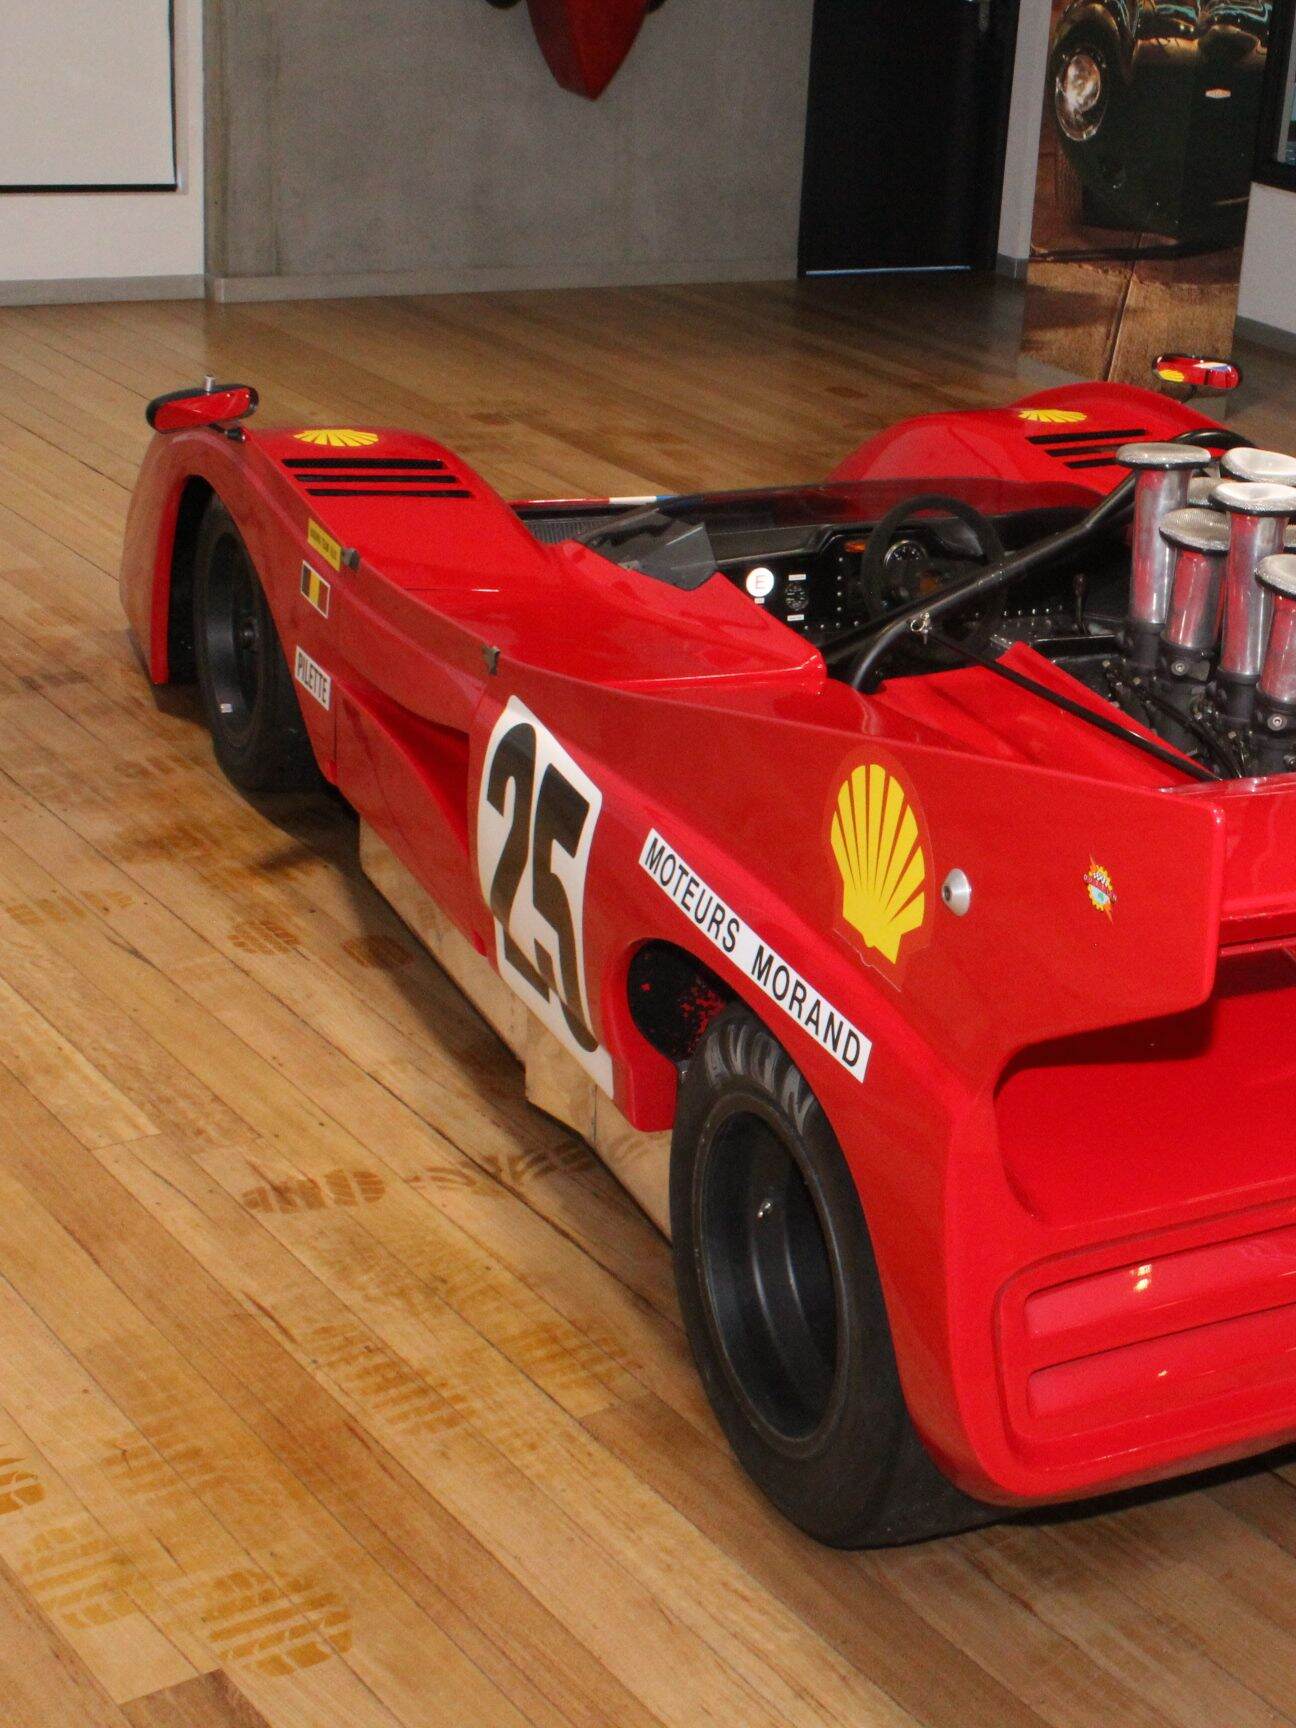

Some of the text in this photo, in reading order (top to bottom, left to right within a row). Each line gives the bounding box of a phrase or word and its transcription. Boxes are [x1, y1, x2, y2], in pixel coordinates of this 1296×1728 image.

[755, 575, 769, 590] E
[297, 651, 328, 704] PILETTE
[486, 723, 599, 1053] 25
[646, 837, 861, 1068] MOTEURS MORAND
